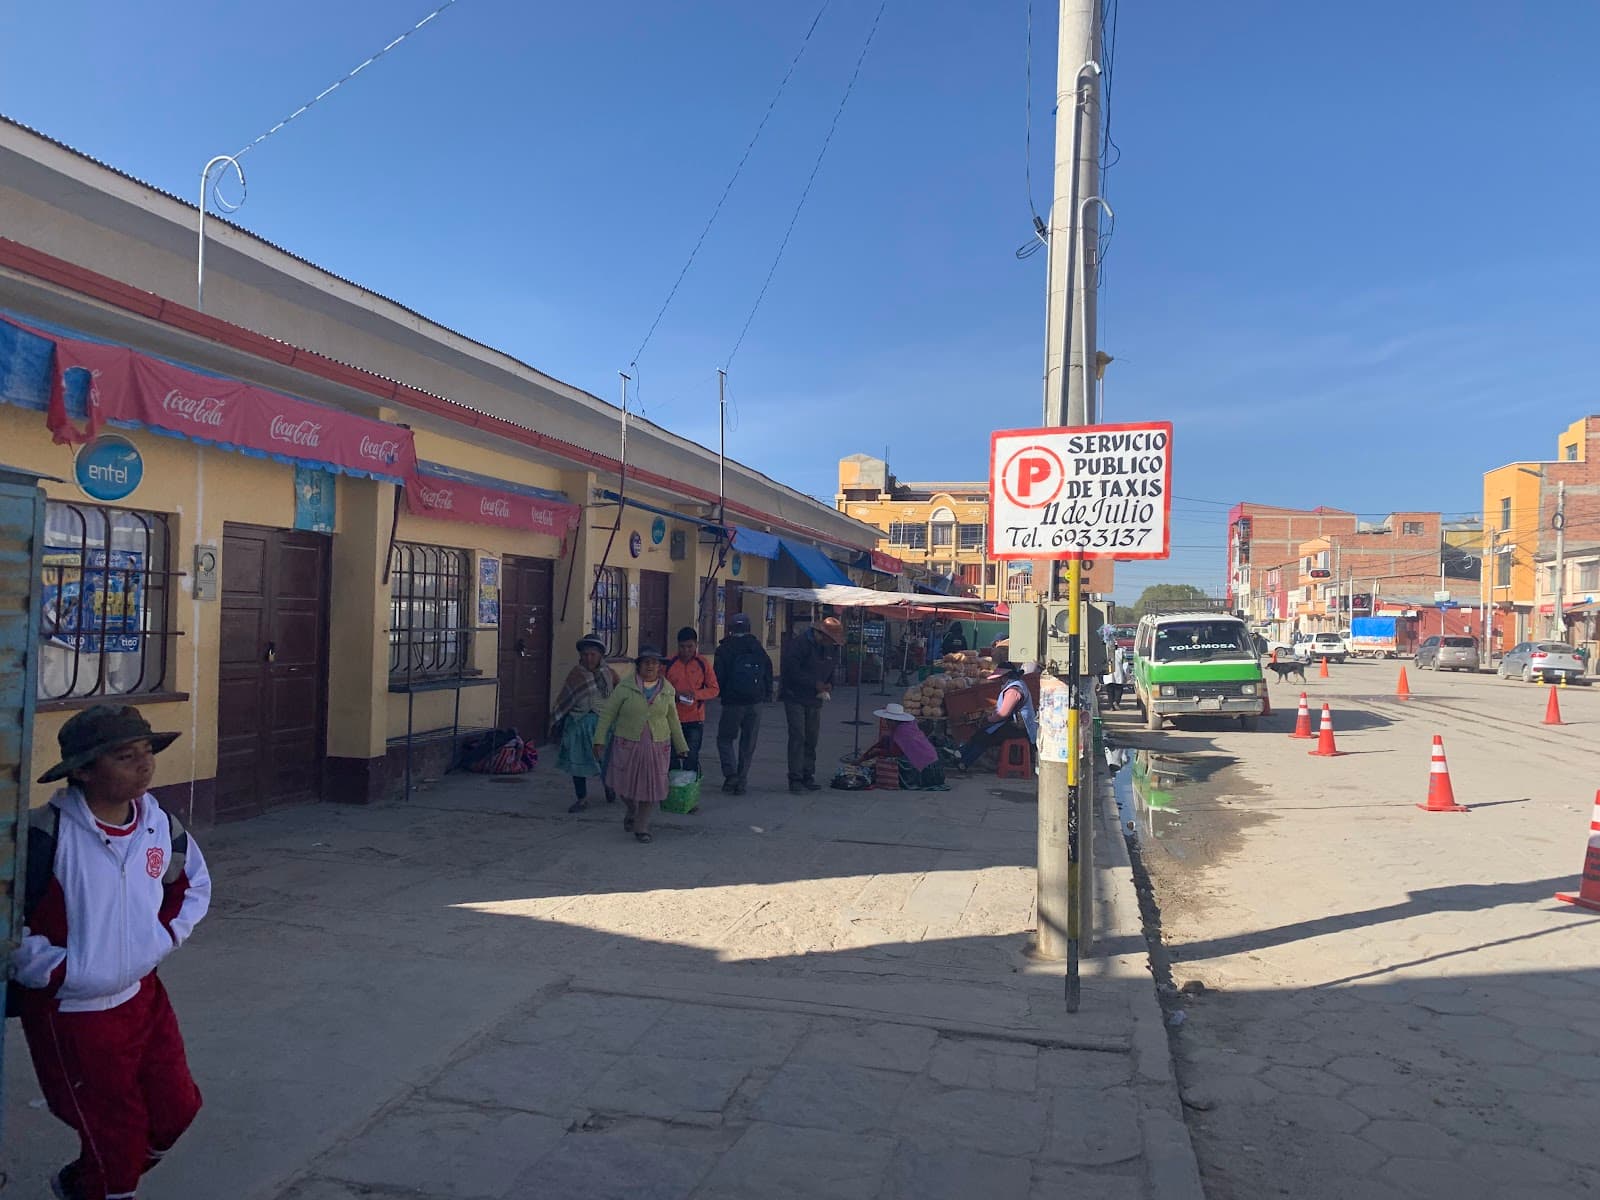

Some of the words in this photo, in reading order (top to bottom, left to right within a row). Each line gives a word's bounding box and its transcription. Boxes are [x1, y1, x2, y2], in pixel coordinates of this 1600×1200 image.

[1067, 432, 1167, 454] SERVICIO
[88, 463, 128, 485] entel
[1073, 455, 1163, 476] PUBLICO
[1018, 458, 1050, 497] P
[1067, 480, 1093, 499] DE
[1099, 478, 1163, 498] TAXIS
[1040, 502, 1060, 525] 11
[1061, 500, 1087, 525] de
[1084, 497, 1154, 527] Julio
[1006, 526, 1043, 548] Tel.
[1051, 528, 1153, 549] 6933137
[1169, 643, 1237, 652] TOLOMOSA
